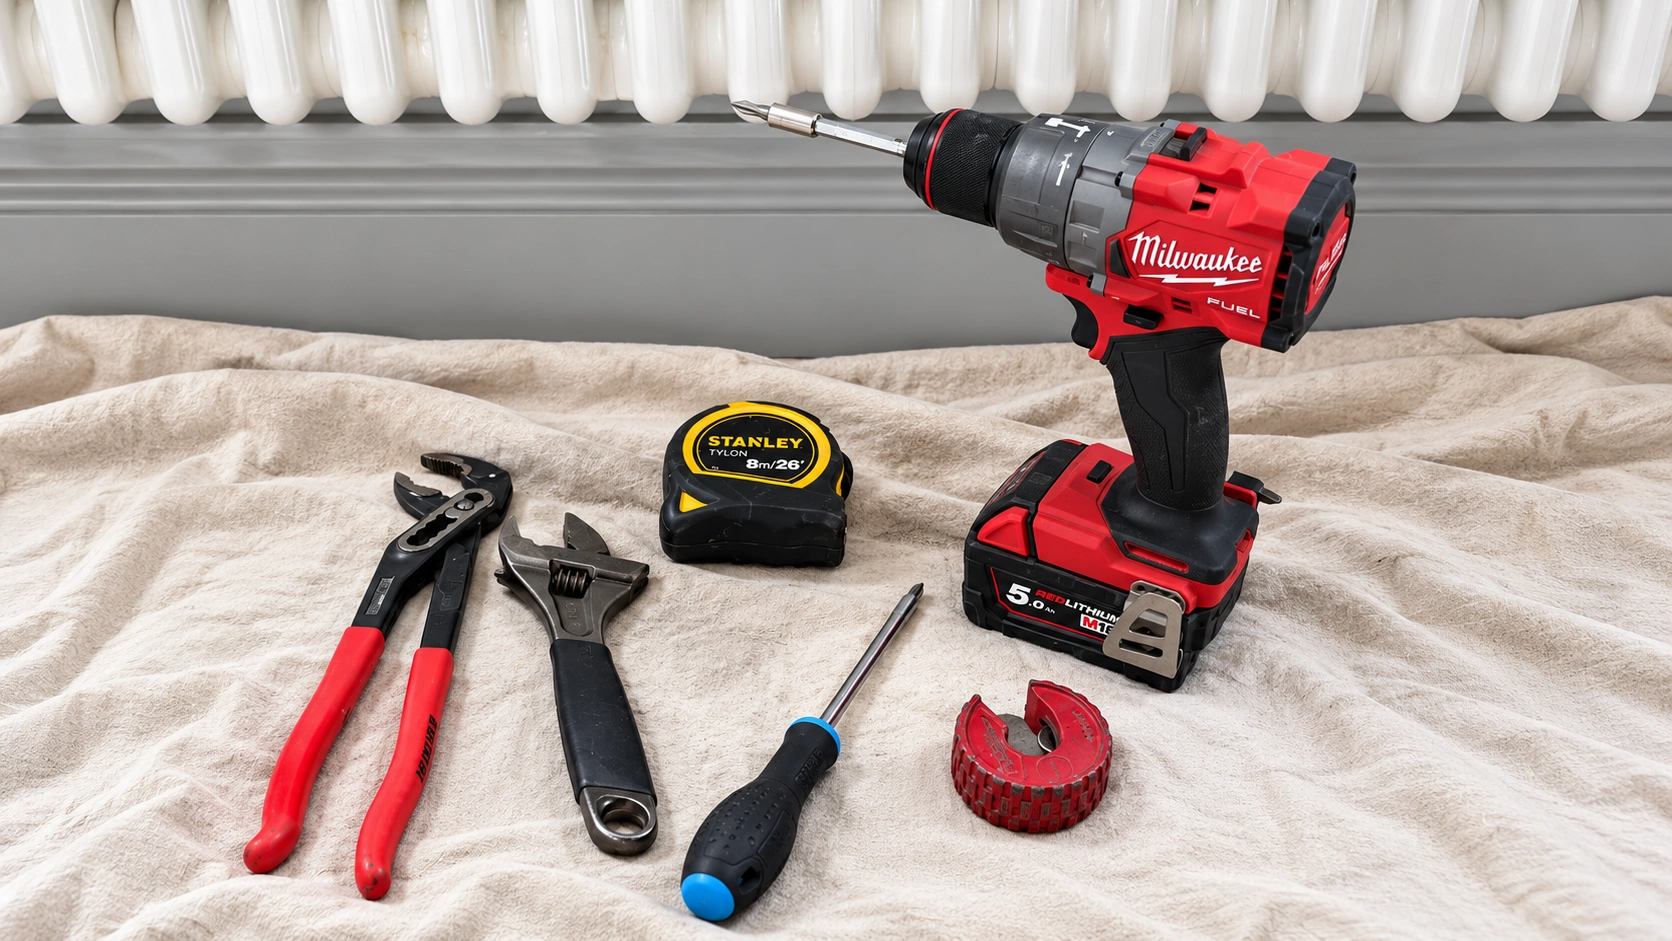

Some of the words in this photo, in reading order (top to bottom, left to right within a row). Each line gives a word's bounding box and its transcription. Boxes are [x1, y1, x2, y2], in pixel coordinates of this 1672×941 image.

[1128, 231, 1263, 273] Milwaukee
[1207, 297, 1261, 319] FUEL
[708, 436, 803, 449] STANLEY
[709, 449, 748, 457] TYLON
[1005, 583, 1045, 610] 5.0
